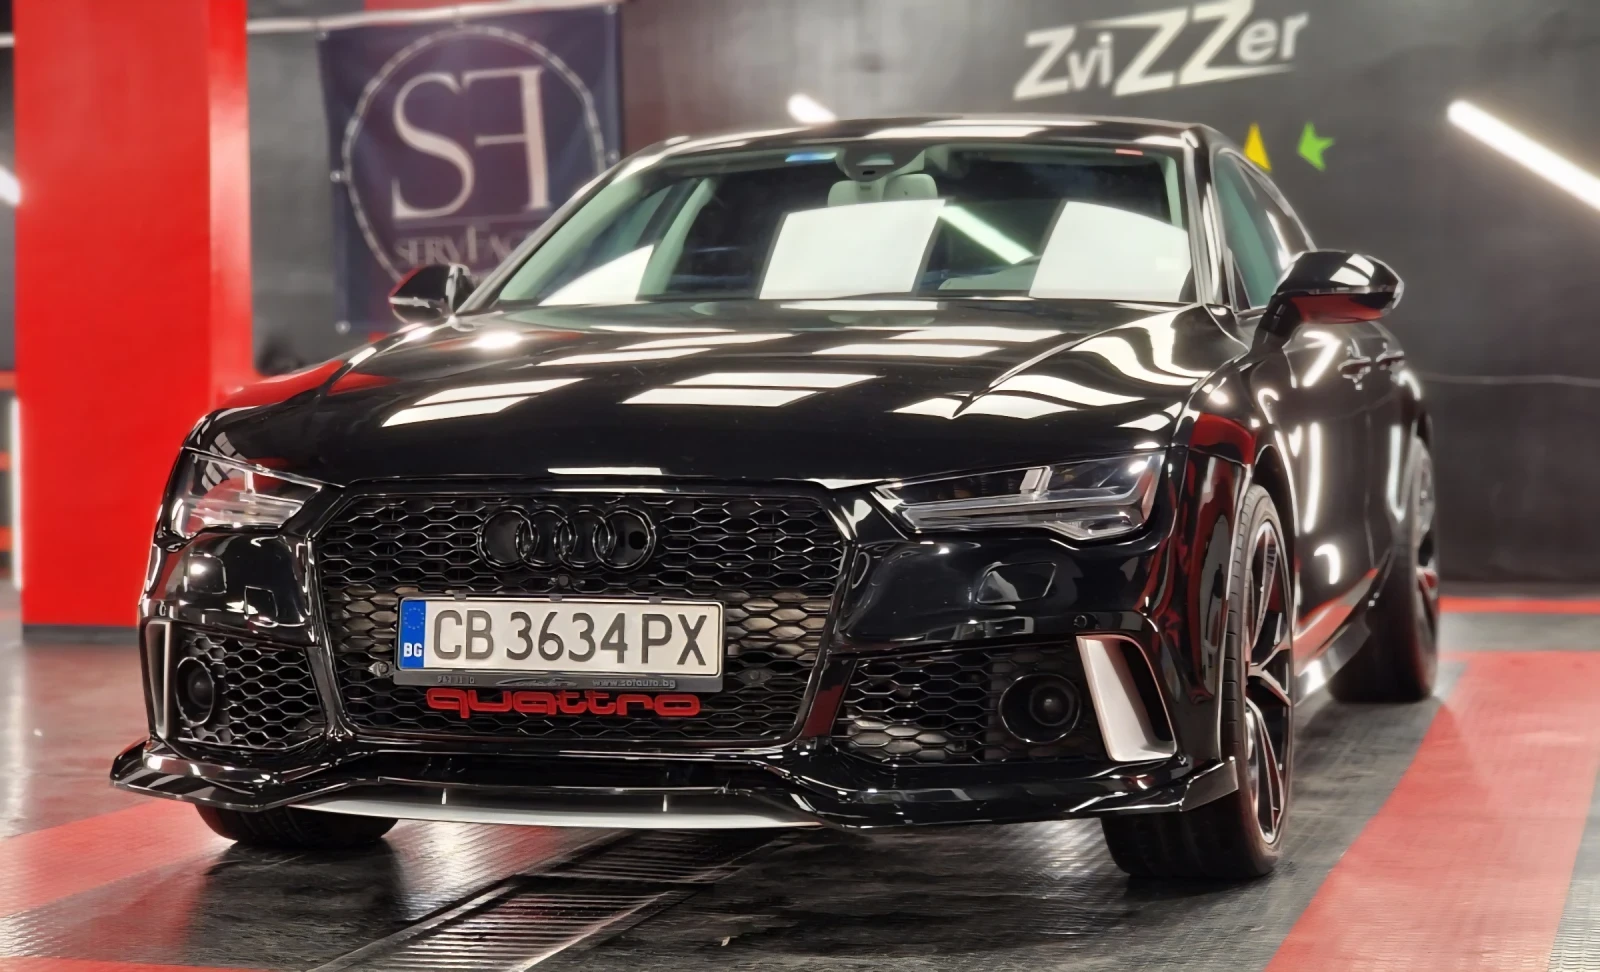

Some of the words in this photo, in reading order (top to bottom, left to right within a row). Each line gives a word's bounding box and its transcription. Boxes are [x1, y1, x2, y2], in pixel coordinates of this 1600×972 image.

[1012, 0, 1308, 100] ZviZZer
[393, 66, 549, 219] SF
[403, 643, 423, 657] BG
[434, 610, 494, 660] CB
[507, 612, 628, 664] 3634
[641, 614, 707, 665] PX
[426, 688, 700, 718] quattro
